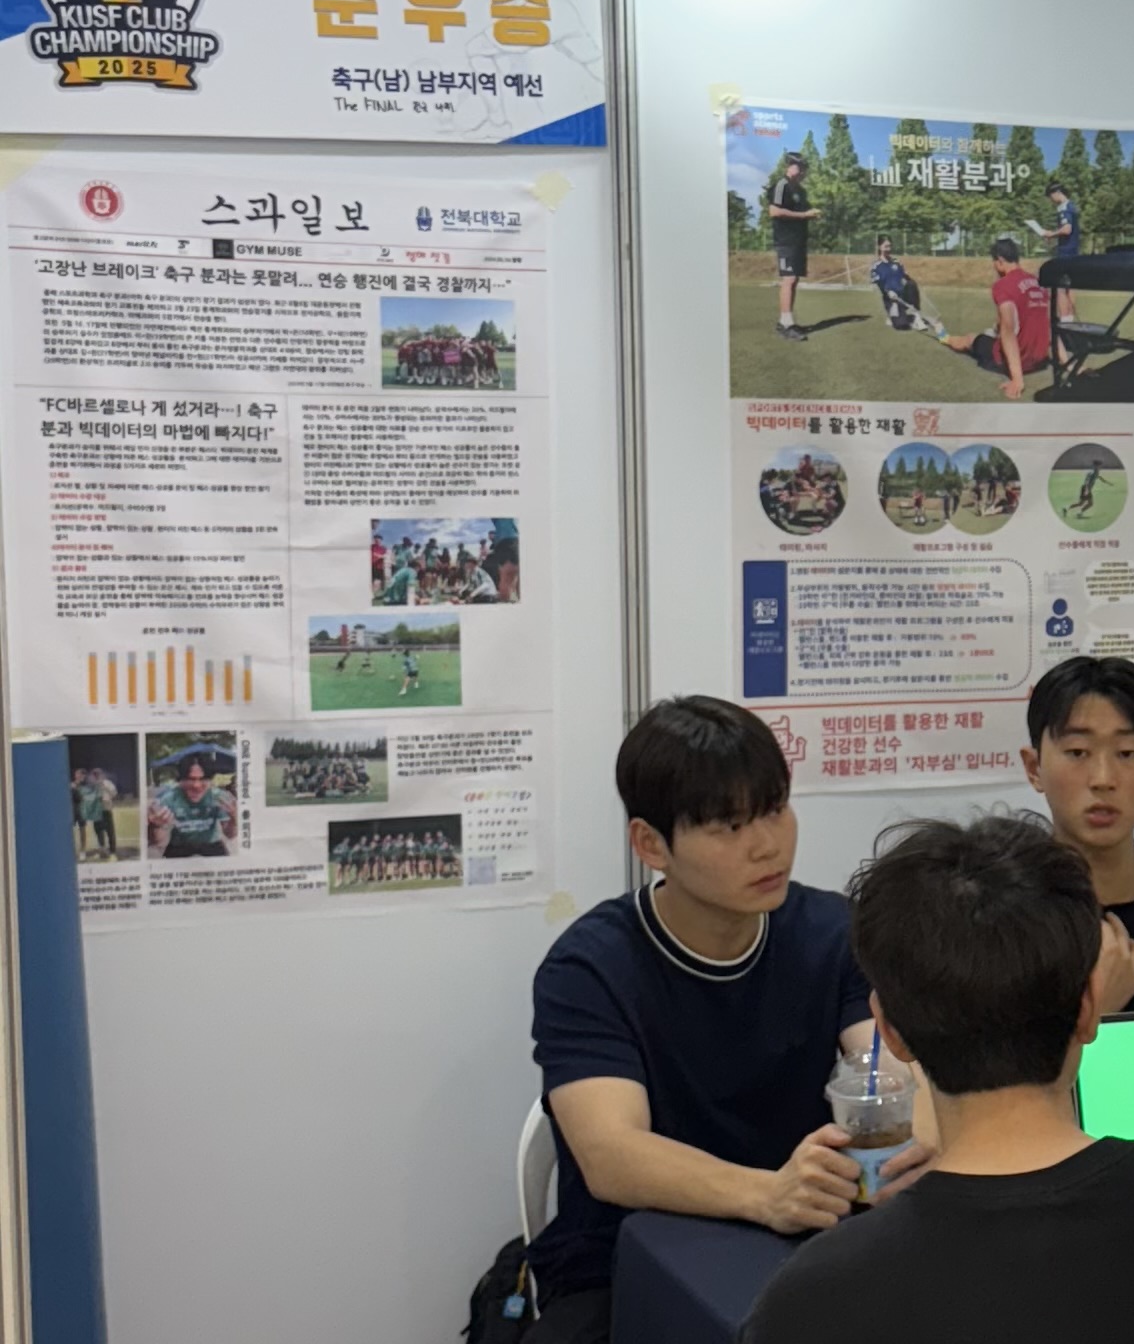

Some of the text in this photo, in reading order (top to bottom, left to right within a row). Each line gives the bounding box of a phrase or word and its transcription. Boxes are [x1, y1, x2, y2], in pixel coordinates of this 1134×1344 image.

[59, 4, 188, 32] KUSF CLUB
[34, 30, 215, 60] CHAMPIONSHIP
[332, 67, 544, 97] 축구(남) 남부지역 예선
[334, 97, 358, 112] The
[364, 97, 403, 112] FINAL
[889, 134, 1007, 155] 빅데이터와 함께하는
[907, 157, 1015, 192] 재활분과
[202, 192, 369, 236] 스과일보
[441, 209, 522, 227] 전북대학교
[237, 244, 302, 256] GYM MUSE
[164, 265, 195, 283] 축구
[201, 267, 246, 286] 분과는
[318, 273, 348, 290] 연승
[353, 274, 397, 292] 행진에
[403, 276, 431, 292] 결국
[152, 400, 167, 416] 게
[248, 402, 278, 419] 축구
[41, 421, 73, 438] 분과
[79, 422, 157, 439] 빅데이터의
[163, 423, 209, 441] 마법에
[747, 416, 906, 435] 빅데이터를 활용한 재활
[822, 711, 984, 733] 빅데이터를 활용한 재활
[822, 736, 902, 756] 건강한 선수
[822, 752, 1015, 777] 재활분과의 '자부심' 입니다.
